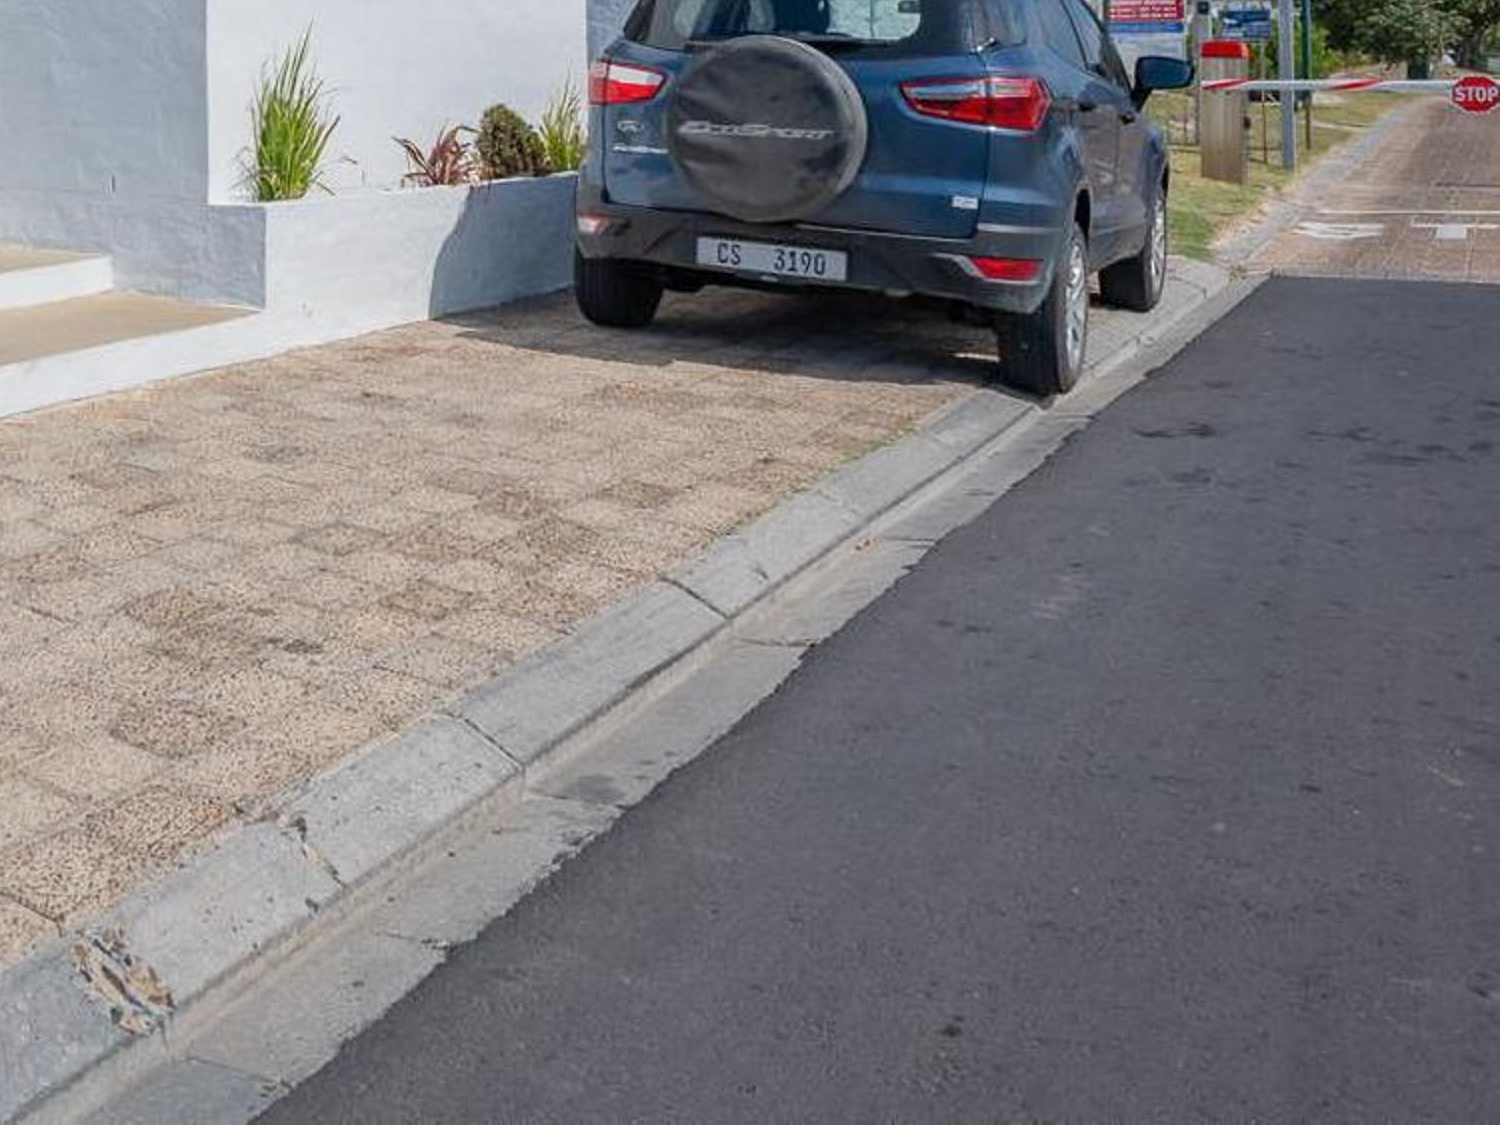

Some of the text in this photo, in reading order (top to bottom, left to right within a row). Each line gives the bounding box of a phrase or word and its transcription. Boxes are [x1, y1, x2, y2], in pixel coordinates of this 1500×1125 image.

[1455, 86, 1499, 102] STOP
[716, 242, 826, 275] CS 3190
